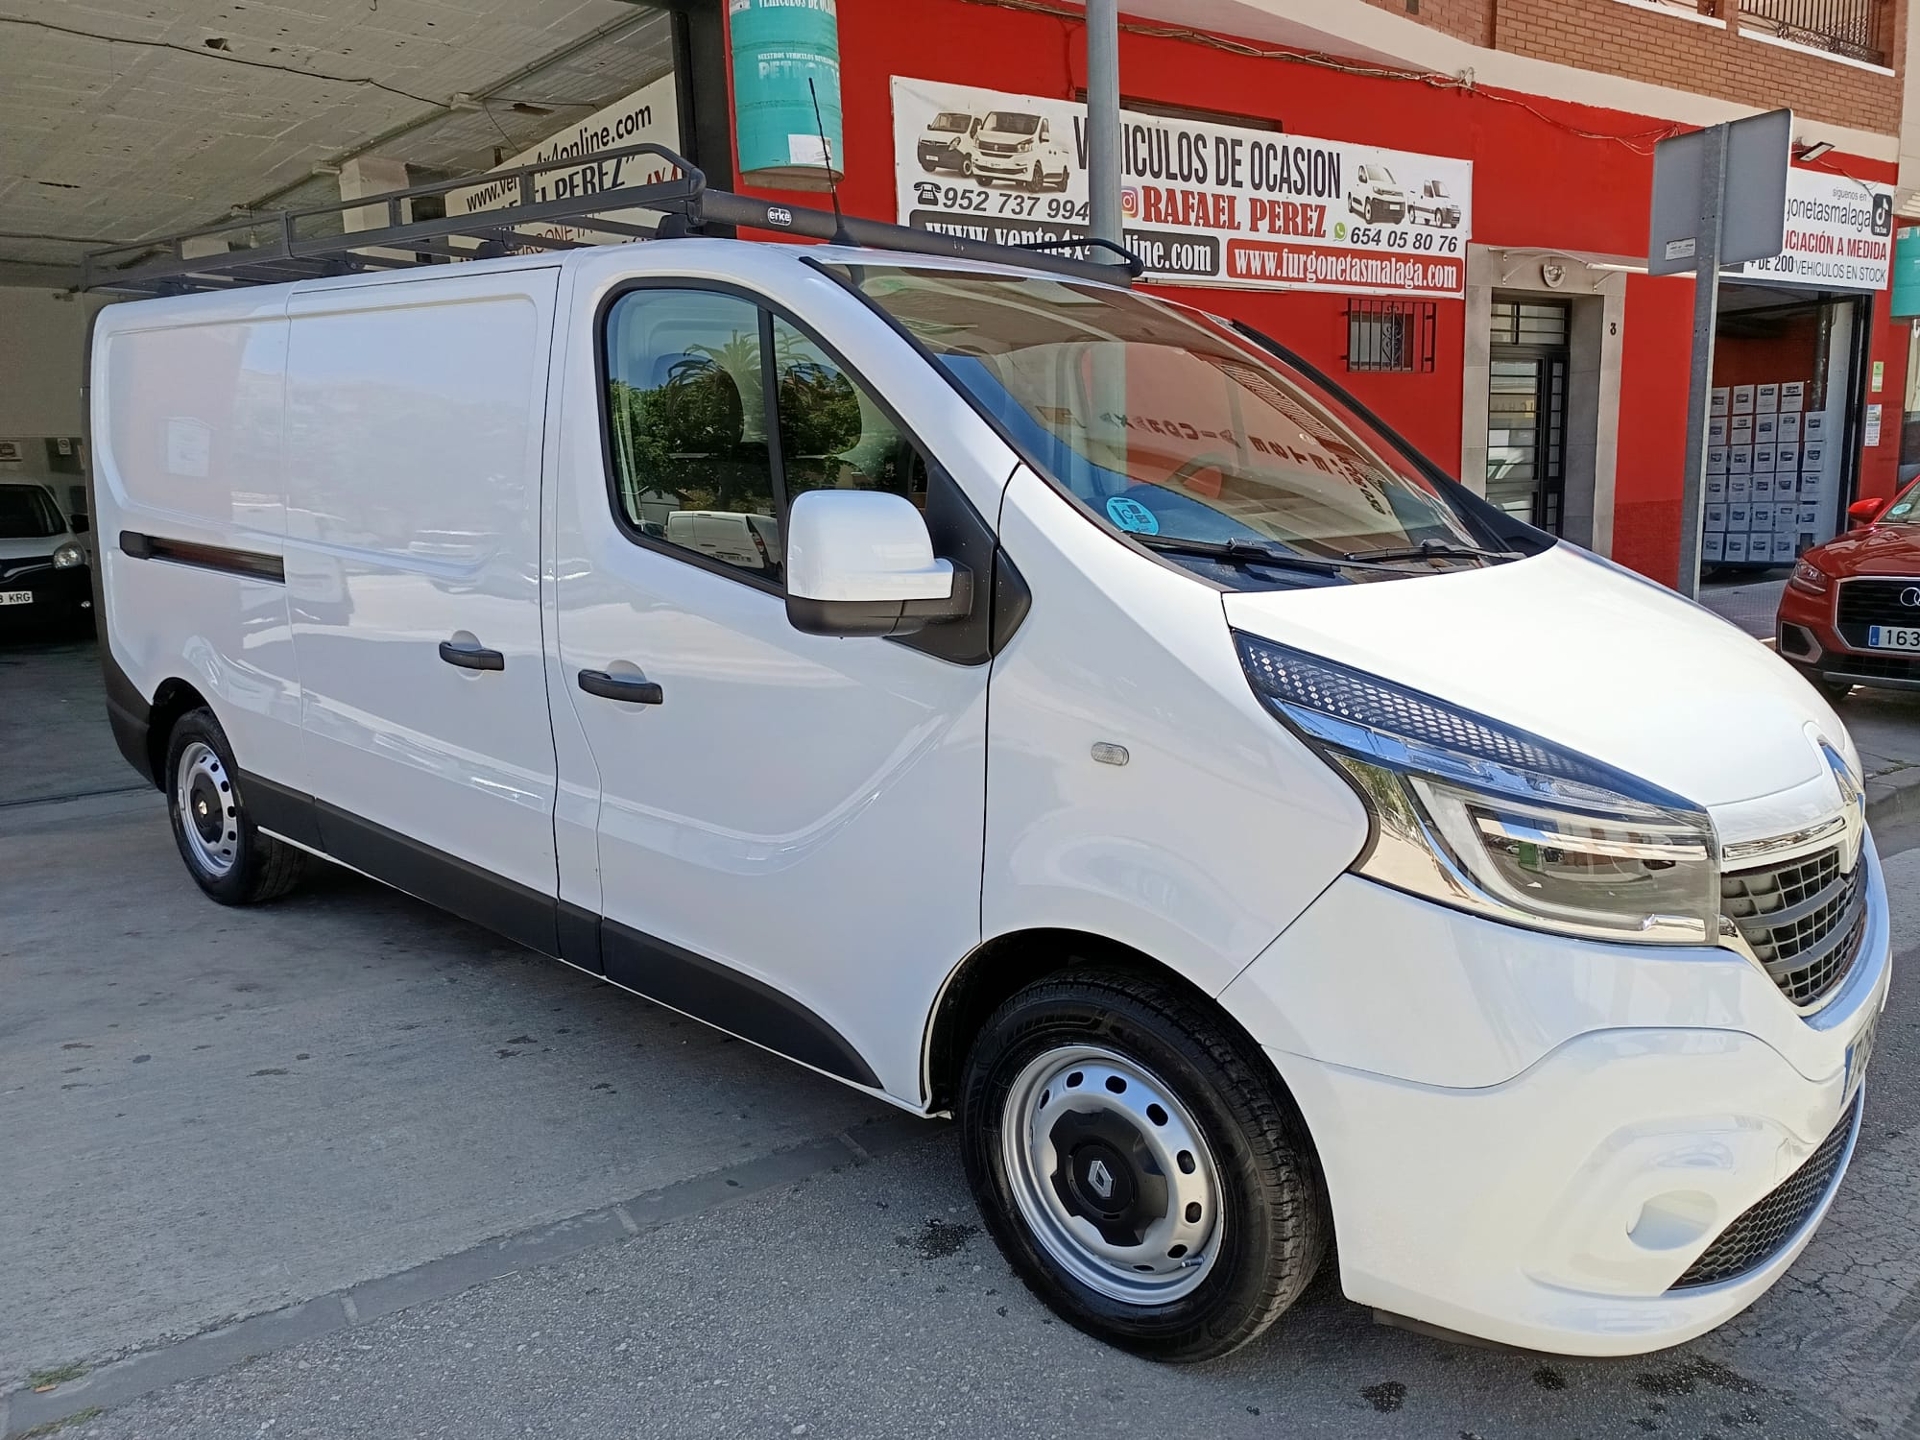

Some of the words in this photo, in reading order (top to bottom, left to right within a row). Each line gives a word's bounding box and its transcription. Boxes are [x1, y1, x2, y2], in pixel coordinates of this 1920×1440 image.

[1073, 115, 1208, 185] VICULOS
[1214, 136, 1243, 188] DE
[1250, 140, 1341, 199] OCASION
[769, 209, 791, 221] erke
[942, 186, 990, 213] 952
[997, 193, 1040, 217] 737
[1046, 199, 1090, 222] 994
[1142, 185, 1241, 231] RAFAEL
[1249, 197, 1327, 238] PEREZ
[1350, 226, 1382, 247] 654
[1387, 230, 1408, 249] 05
[1412, 233, 1433, 252] 80
[1438, 234, 1458, 253] 76
[1836, 237, 1844, 256] A
[1847, 238, 1887, 260] MEDIDA
[1234, 247, 1457, 289] www.furgonetasmalaga.com
[1758, 258, 1771, 271] DE
[1774, 255, 1794, 273] 200
[1846, 265, 1857, 280] EN
[1860, 267, 1886, 283] STOCK
[9, 592, 31, 603] KRG
